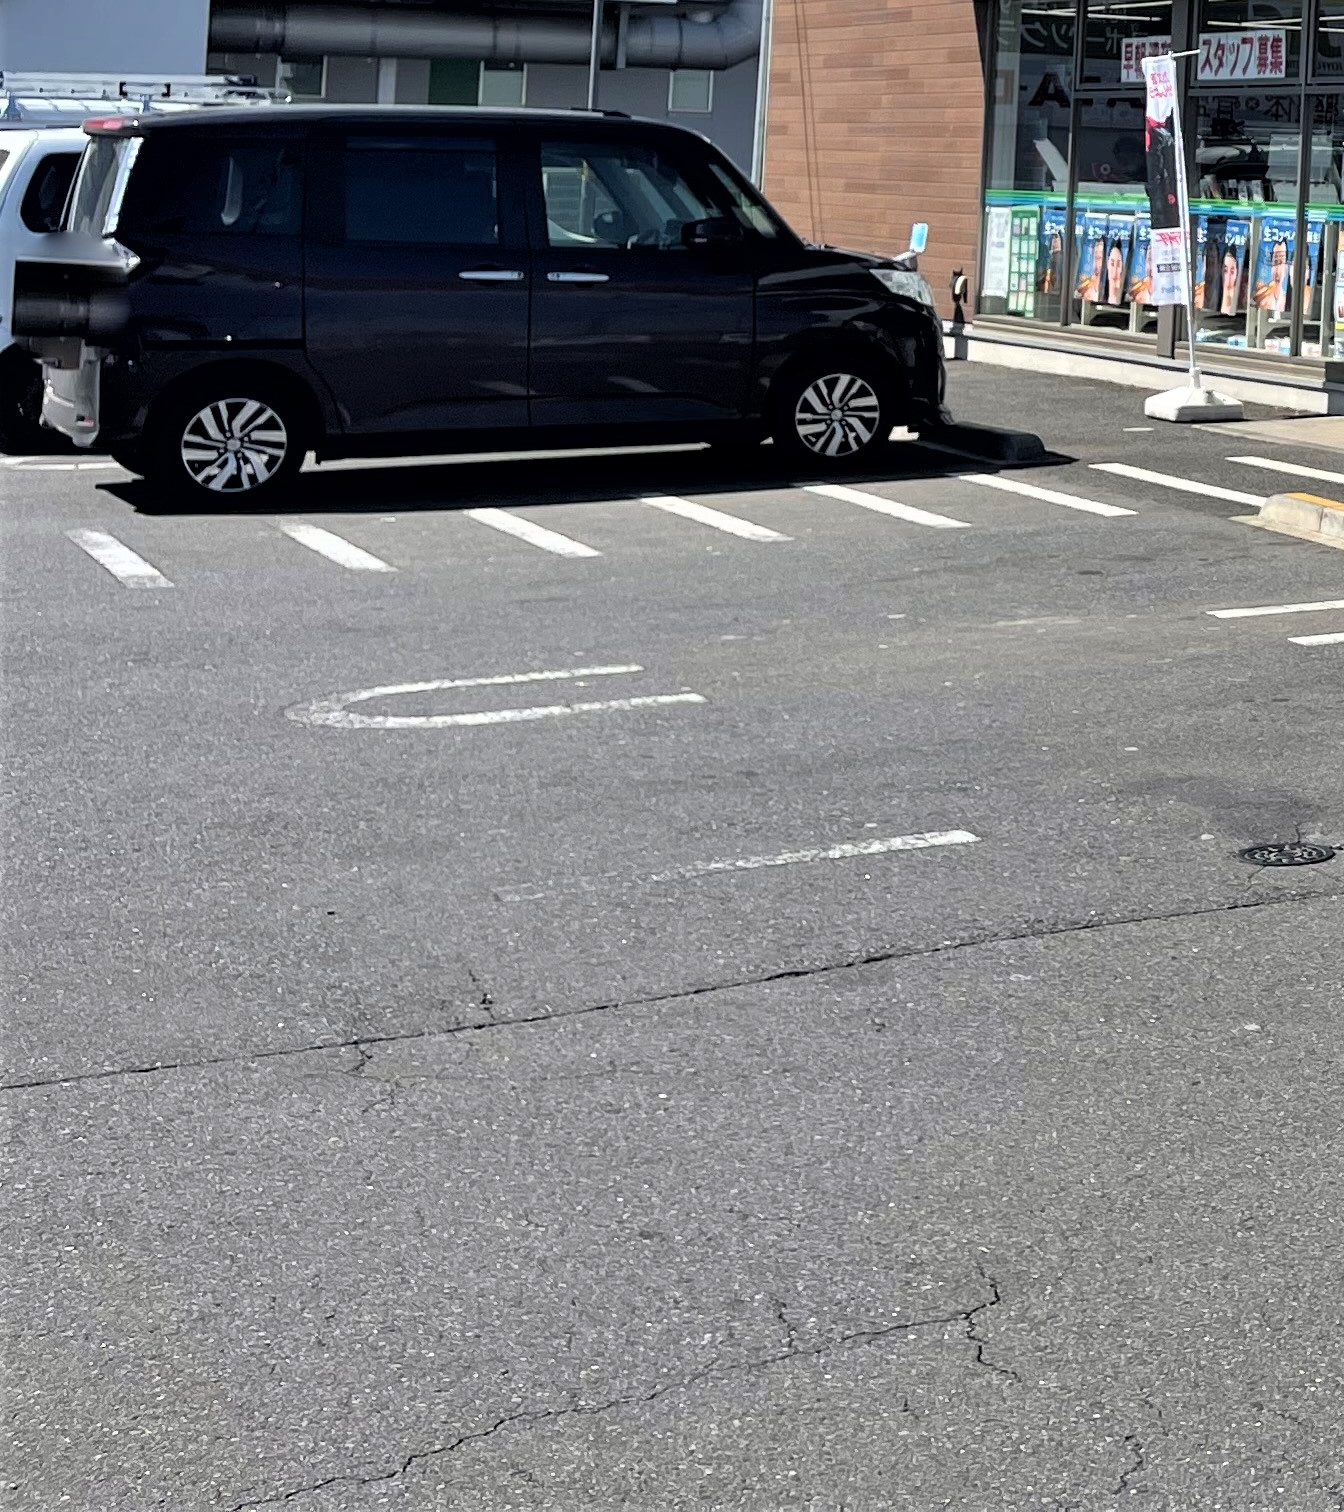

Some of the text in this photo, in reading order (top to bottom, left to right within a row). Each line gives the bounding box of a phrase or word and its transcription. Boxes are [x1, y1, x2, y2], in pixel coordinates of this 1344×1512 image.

[1201, 35, 1283, 76] スタッフ募集
